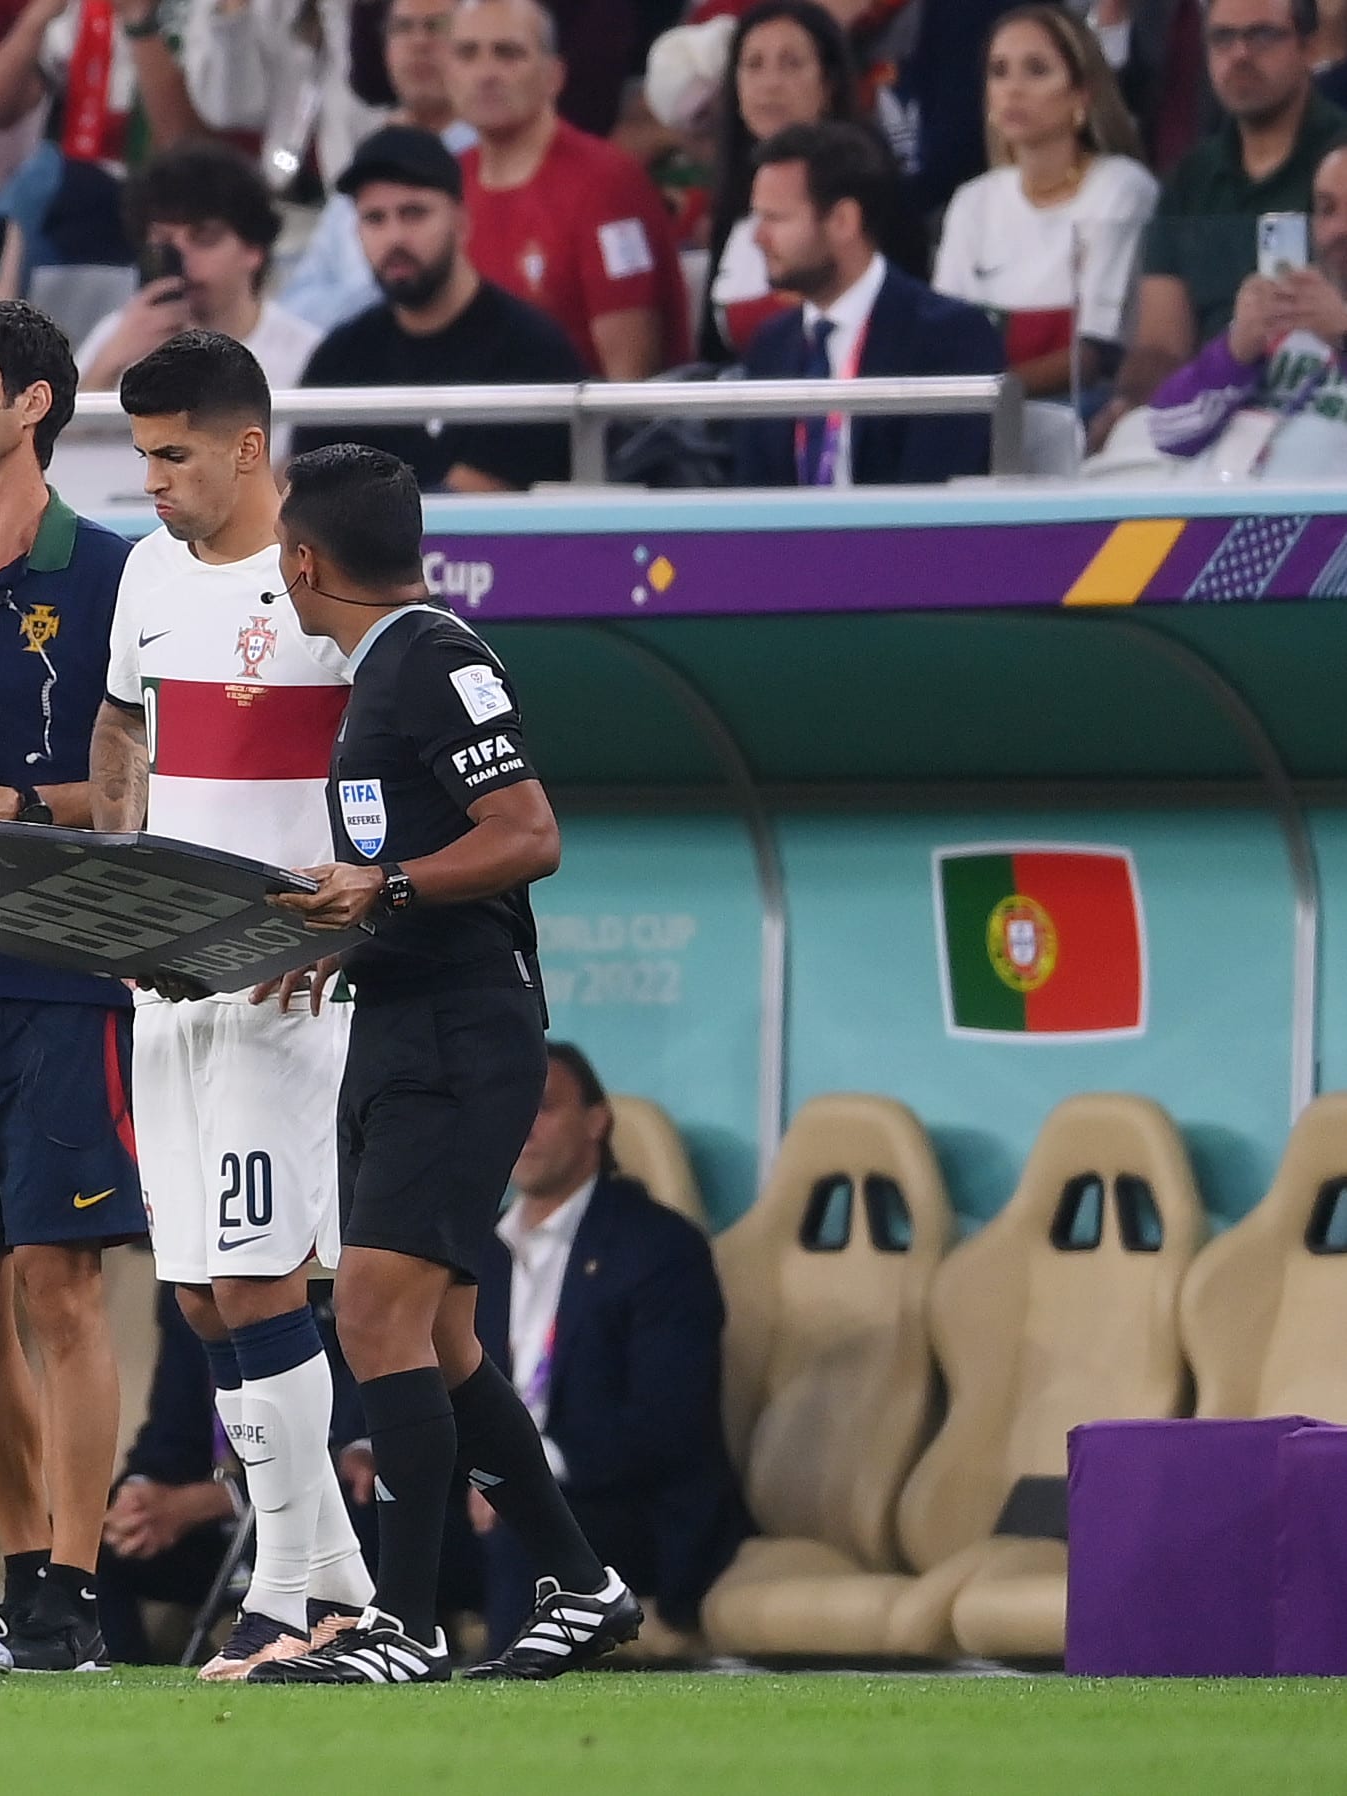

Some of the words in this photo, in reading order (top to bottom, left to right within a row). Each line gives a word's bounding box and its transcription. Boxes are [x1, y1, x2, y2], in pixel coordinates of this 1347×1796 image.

[422, 551, 495, 607] Cup
[451, 734, 516, 774] FIFA
[465, 766, 499, 788] TEAM
[499, 758, 525, 773] ONE
[342, 784, 378, 803] FIFA
[346, 814, 383, 826] REFEREE
[159, 917, 319, 980] HUBLOT
[219, 1150, 274, 1229] 20
